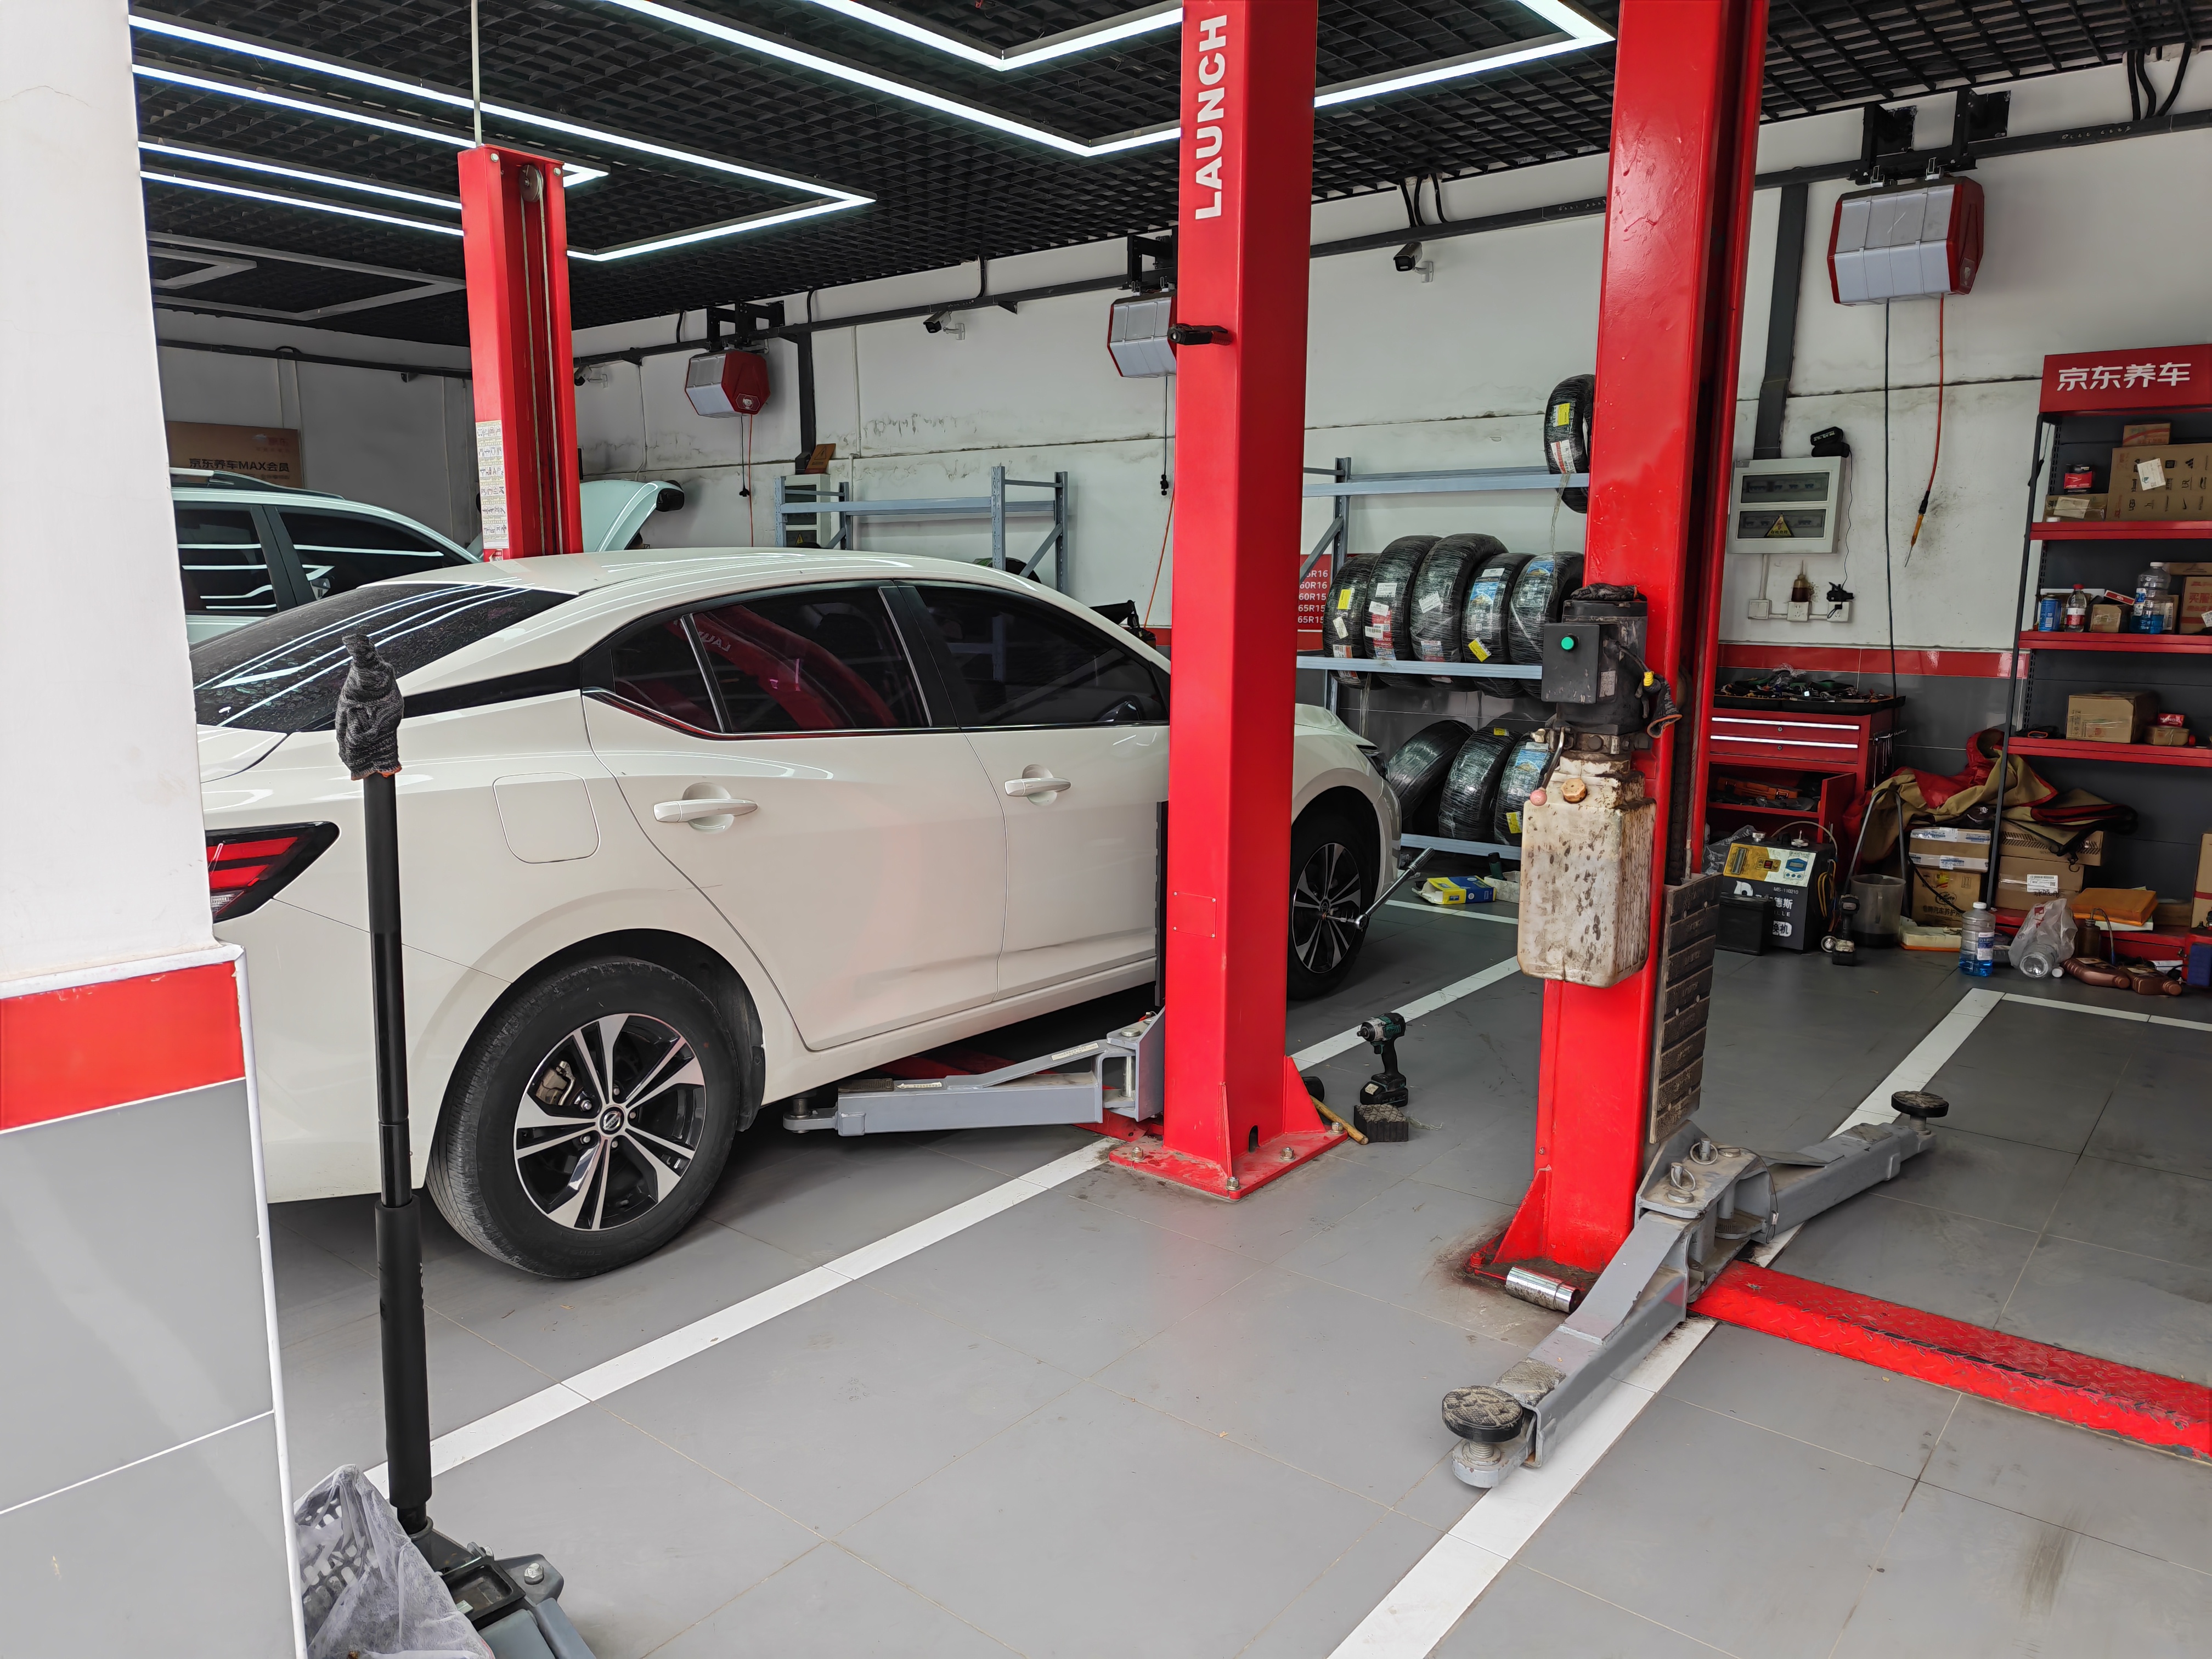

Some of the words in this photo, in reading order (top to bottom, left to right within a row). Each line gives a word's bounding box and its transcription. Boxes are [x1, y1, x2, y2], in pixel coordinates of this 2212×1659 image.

[1195, 14, 1227, 220] LAUNCH
[2057, 362, 2192, 391] 京东养车
[189, 458, 290, 472] 京东养车MAX会员
